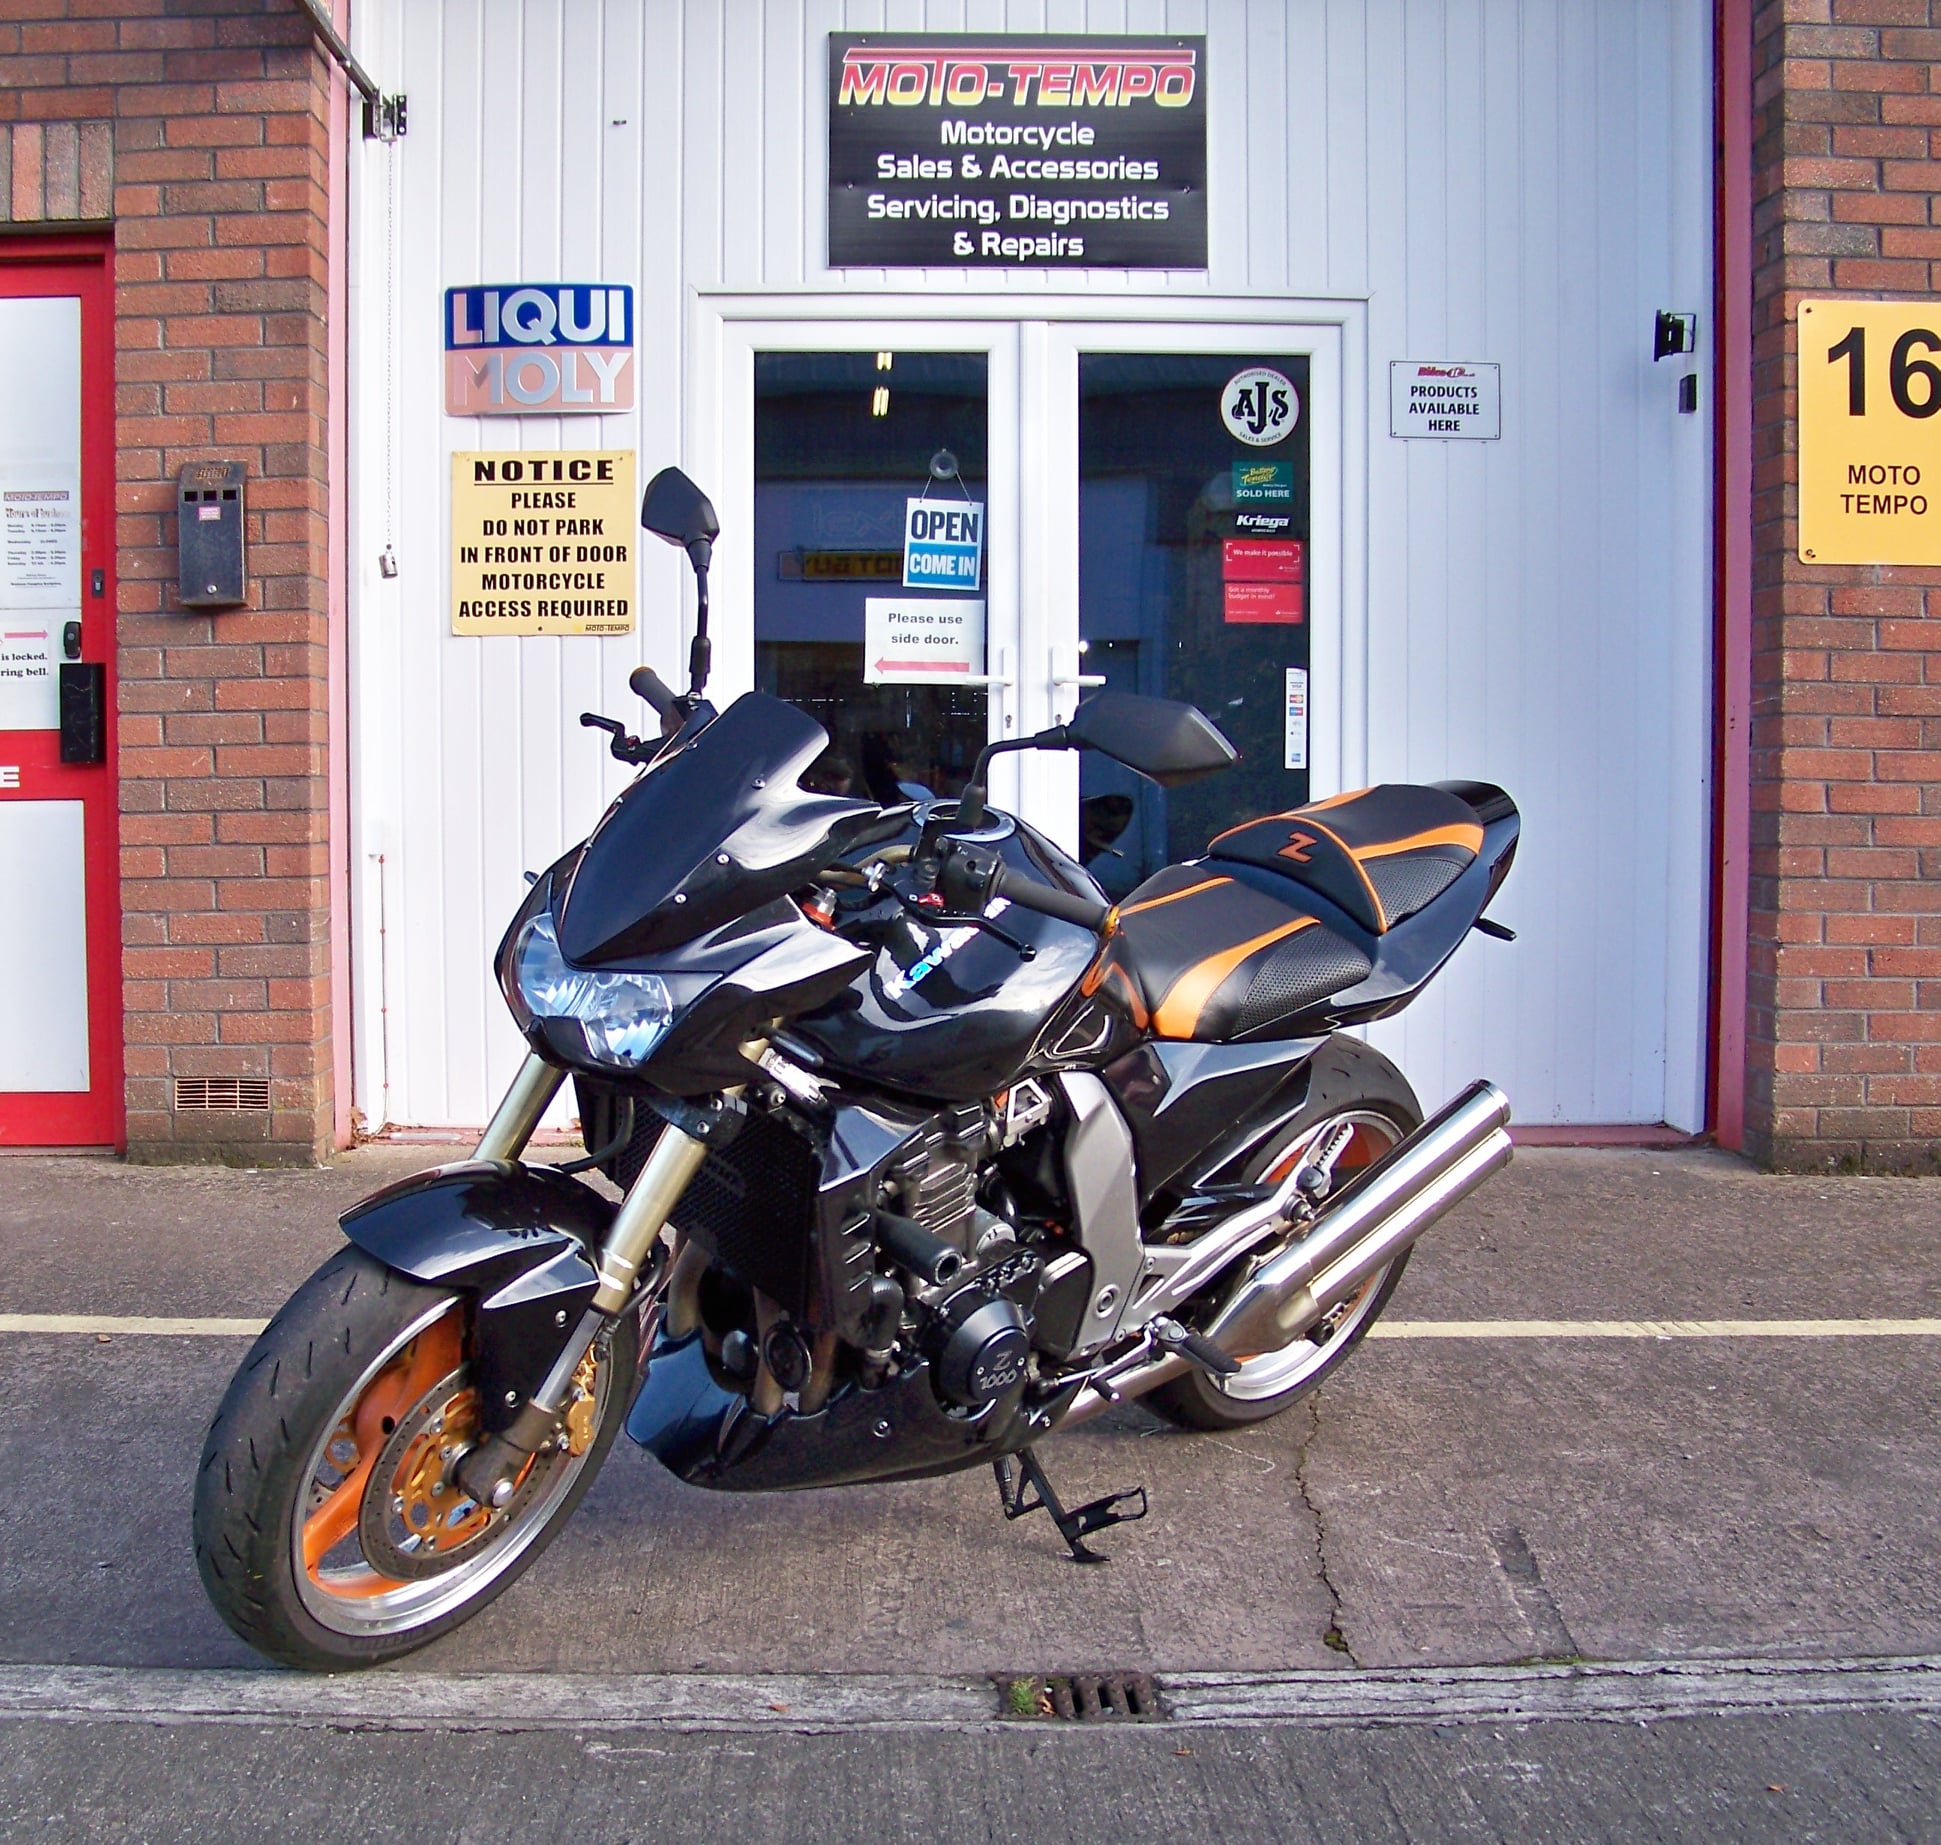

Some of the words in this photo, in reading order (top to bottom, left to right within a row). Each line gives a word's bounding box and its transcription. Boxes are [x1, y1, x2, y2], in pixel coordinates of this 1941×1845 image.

[839, 54, 1196, 107] MOTO-TEMPO
[941, 121, 1095, 151] Motorcycle
[877, 154, 953, 179] Sales
[961, 154, 983, 178] &
[990, 155, 1159, 181] Accessories
[867, 194, 1001, 225] Servicing,
[1009, 195, 1169, 225] Diagnostics
[953, 231, 975, 256] &
[982, 232, 1084, 261] Repairs
[452, 288, 626, 346] LIQUI
[454, 351, 632, 406] MOLY
[1267, 371, 1287, 386] DEALER
[1827, 326, 1941, 420] 16
[1410, 385, 1478, 399] PRODUCTS
[1231, 382, 1289, 435] AJS
[1408, 402, 1480, 416] AVAILABLE
[1428, 419, 1461, 432] HERE
[1239, 432, 1255, 442] SALES
[1260, 432, 1282, 442] SERVICE
[474, 459, 614, 482] NOTICE
[1848, 464, 1921, 486] MOTO
[511, 492, 577, 509] PLEASE
[1236, 489, 1263, 498] SOLD
[1264, 489, 1291, 498] HERE
[1840, 494, 1928, 516] TEMPO
[482, 519, 511, 536] DO
[514, 519, 550, 536] NOT
[555, 518, 604, 536] PARK
[910, 509, 979, 543] OPEN
[1236, 514, 1290, 529] Kriega
[460, 547, 479, 564] IN
[484, 546, 545, 563] FRONT
[549, 546, 572, 563] OF
[576, 545, 628, 563] DOOR
[1244, 549, 1261, 557] make
[1267, 550, 1293, 558] possible
[909, 552, 956, 575] COME
[957, 556, 976, 577] IN
[481, 573, 606, 591] MOTORCYCLE
[458, 600, 532, 618] ACCESS
[537, 599, 629, 618] REQUIRED
[888, 613, 935, 625] Please
[938, 614, 963, 625] use
[891, 632, 921, 645] side
[924, 632, 960, 645] door.
[1, 653, 10, 661] is
[12, 652, 48, 661] locked.
[1, 668, 24, 678] ring
[26, 667, 49, 677] bell.
[992, 1349, 1014, 1371] Z
[979, 1368, 1018, 1390] 1000
